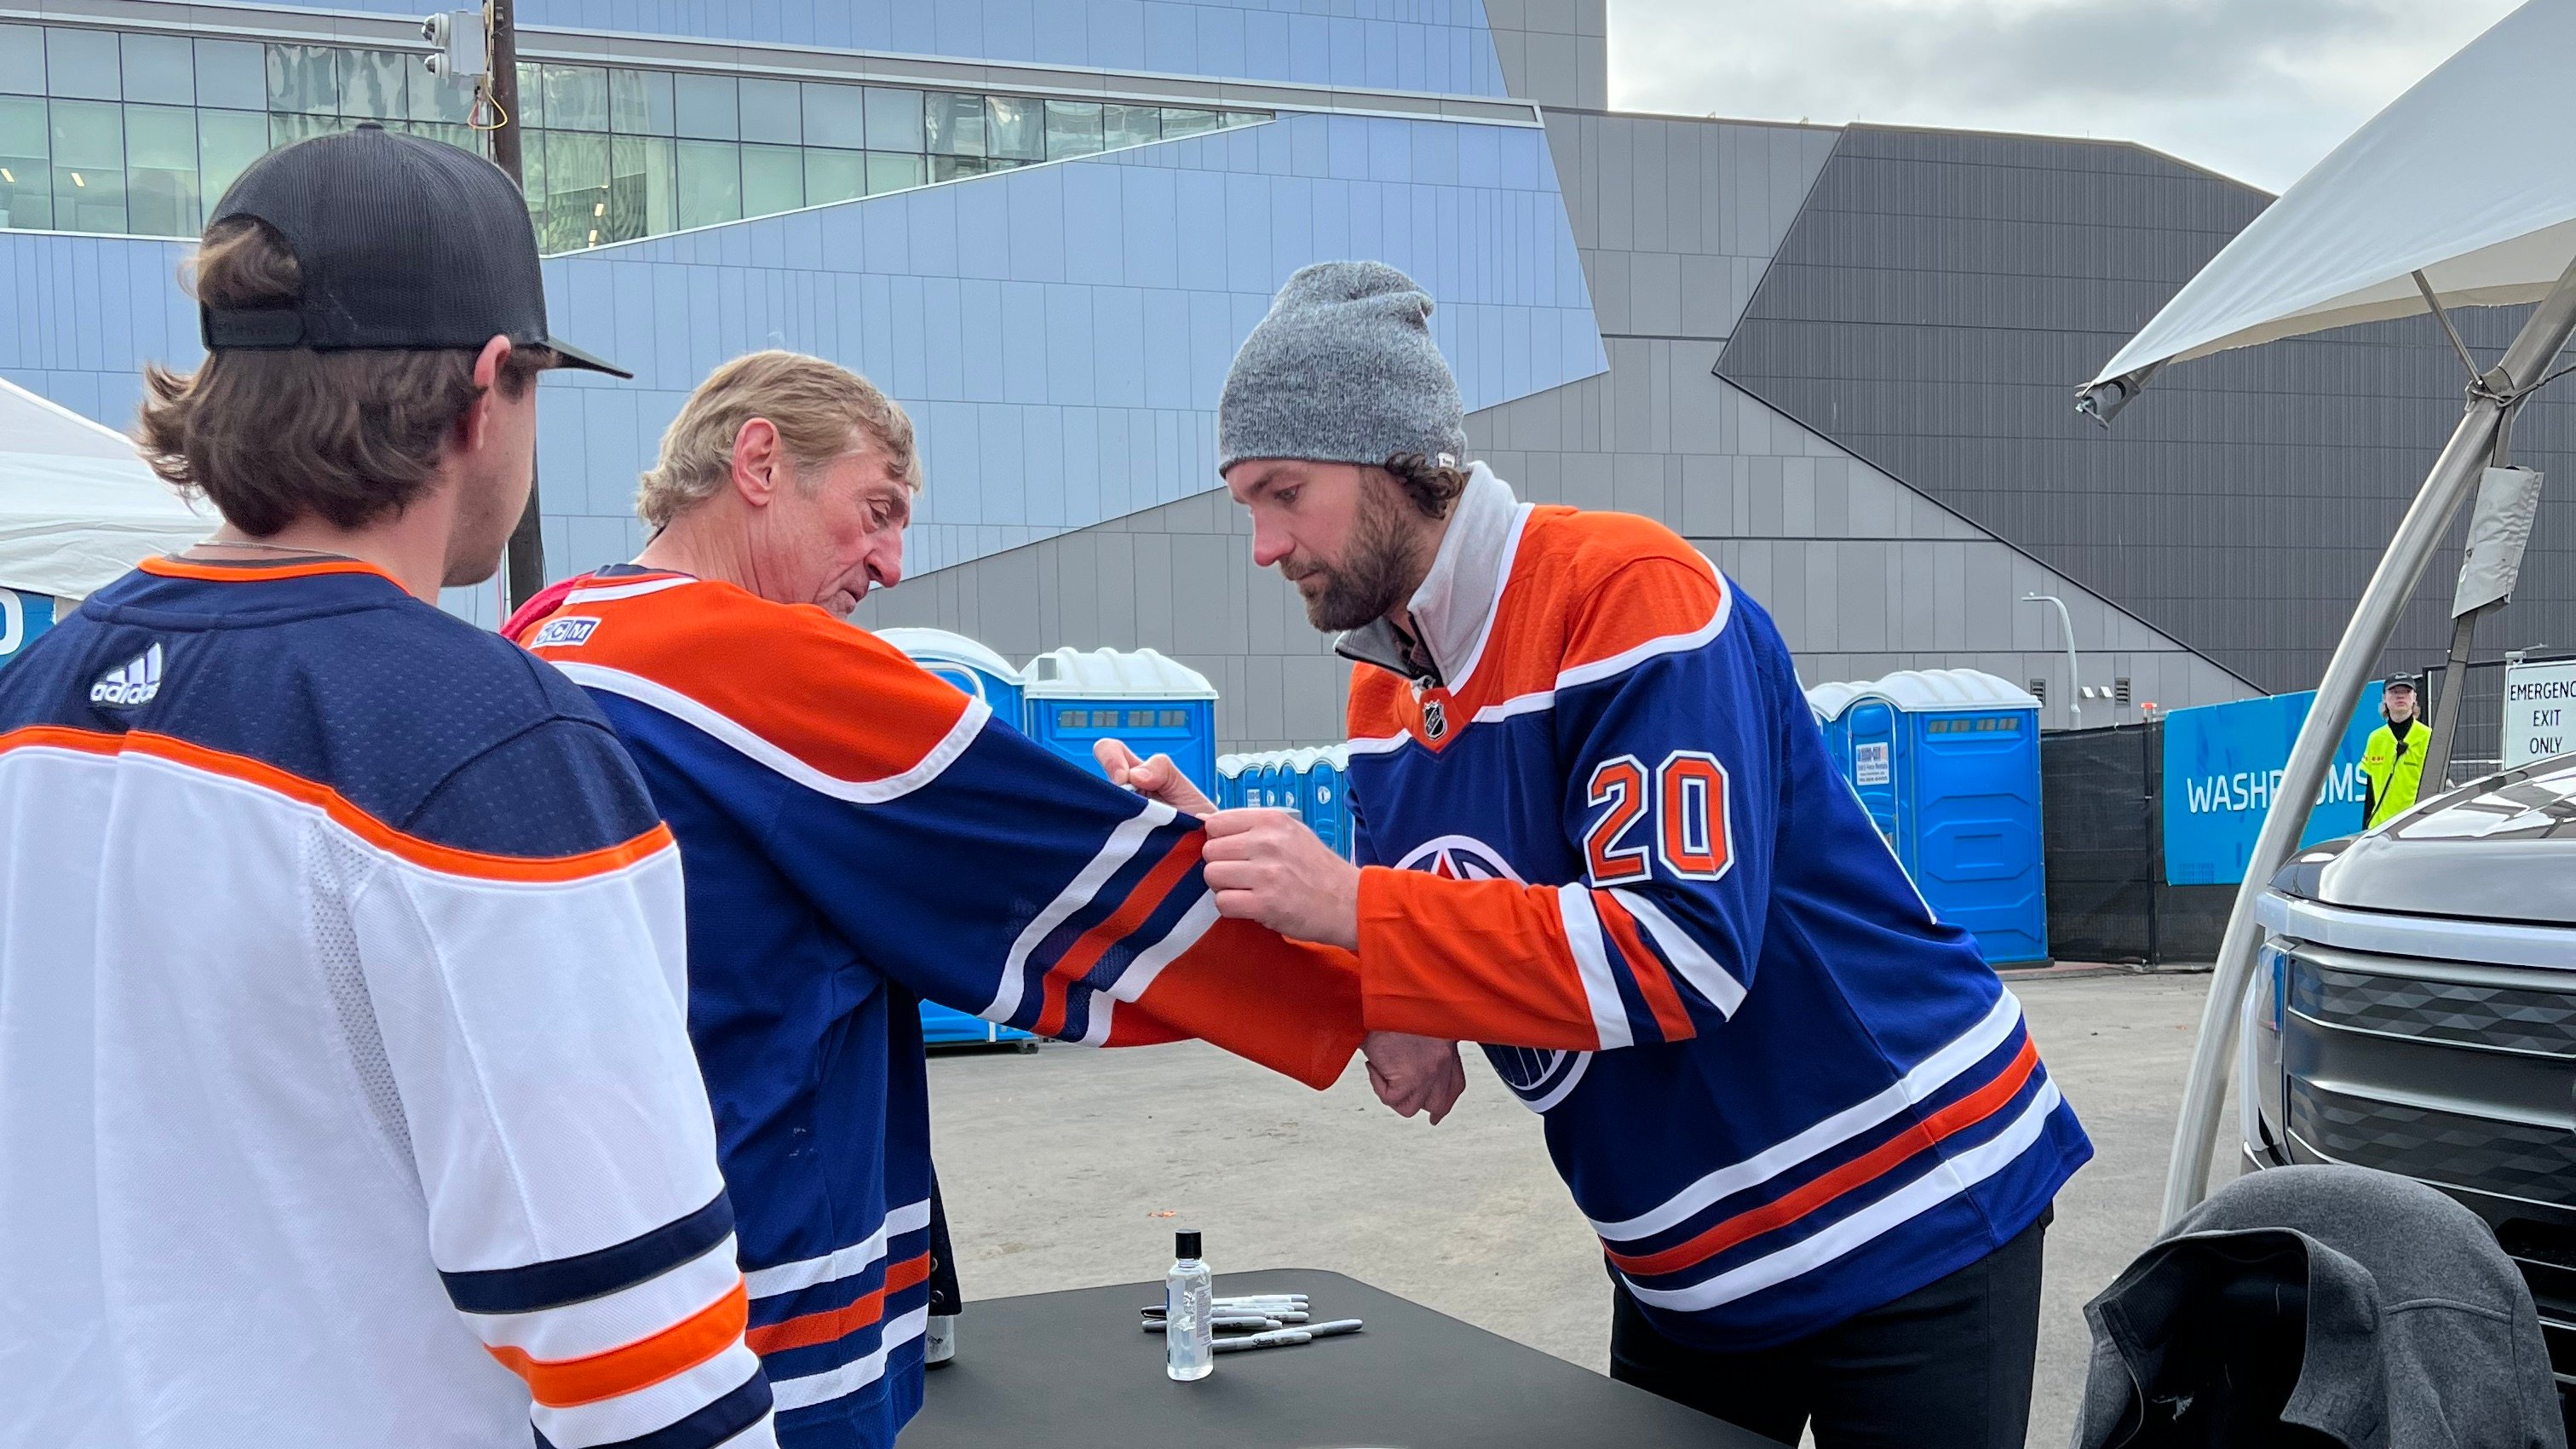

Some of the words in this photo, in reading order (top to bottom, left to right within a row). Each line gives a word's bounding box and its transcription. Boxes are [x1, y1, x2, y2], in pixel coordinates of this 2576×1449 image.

[89, 681, 161, 704] adidas
[2533, 709, 2562, 727] EXIT
[2529, 737, 2562, 754] ONLY
[2186, 762, 2368, 814] WASHRMS
[1583, 750, 1735, 888] 20
